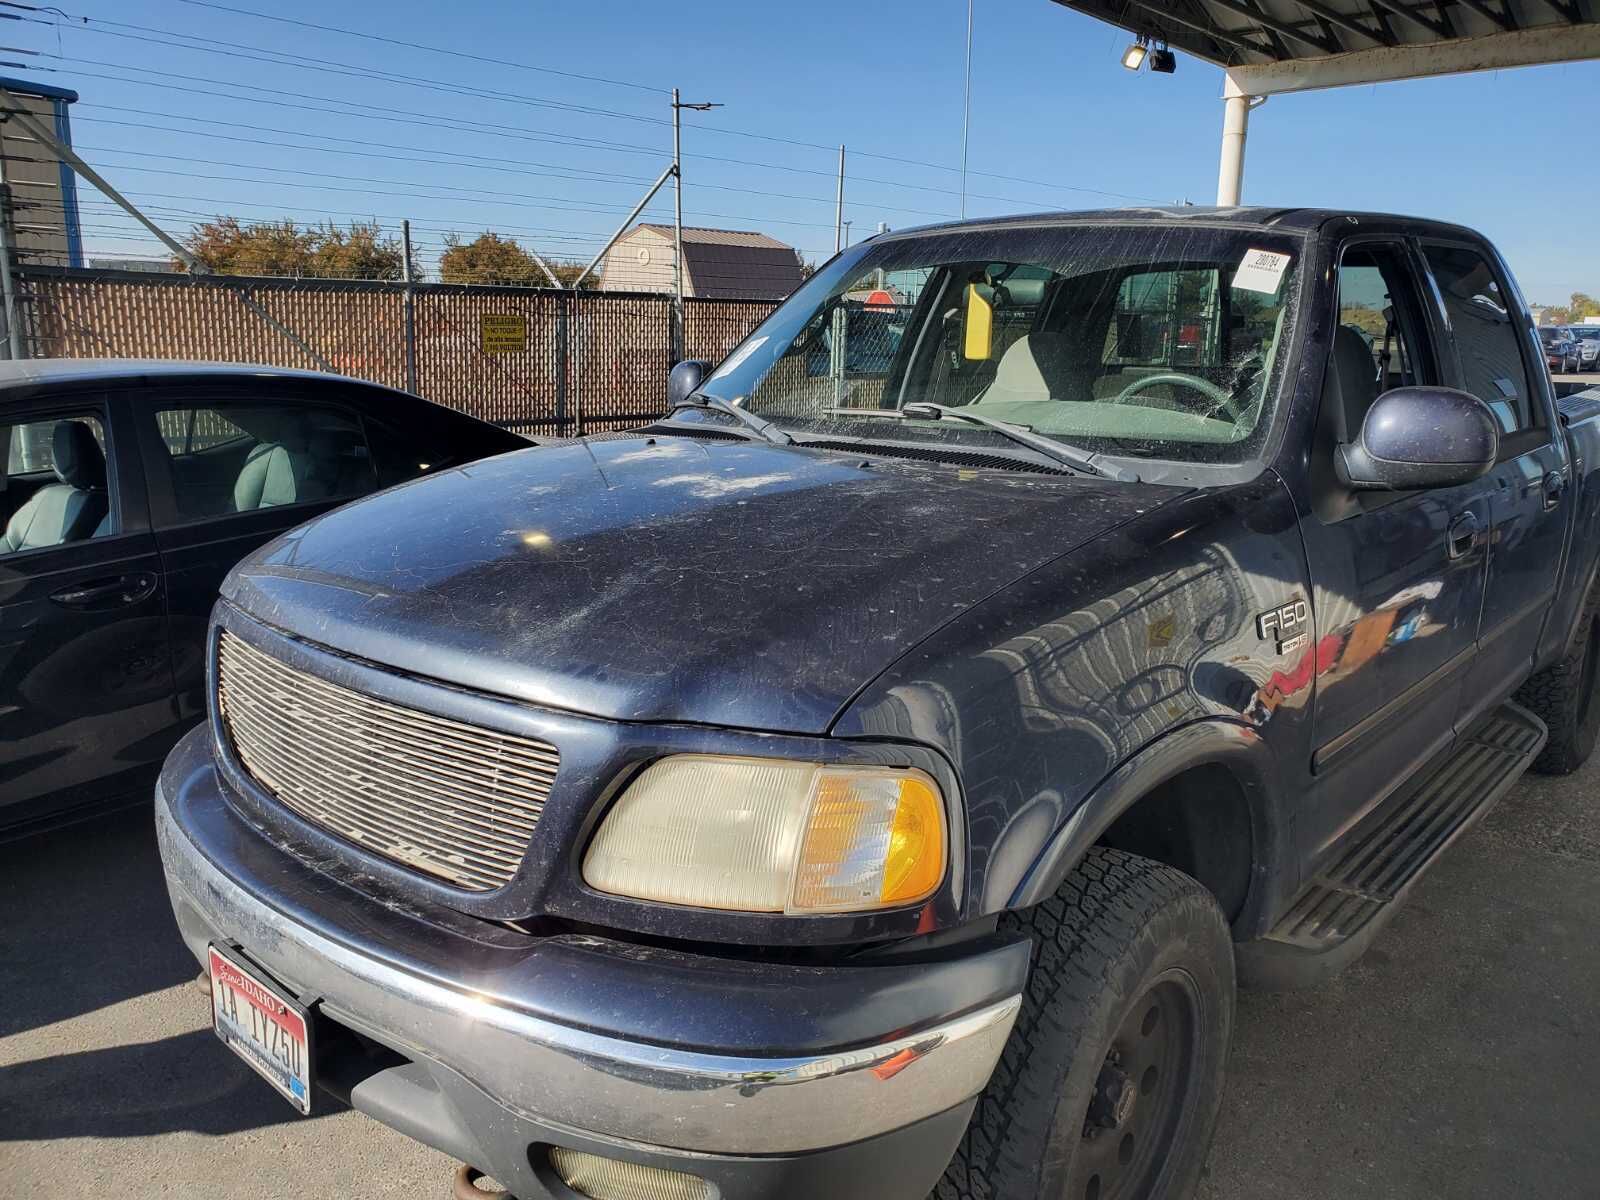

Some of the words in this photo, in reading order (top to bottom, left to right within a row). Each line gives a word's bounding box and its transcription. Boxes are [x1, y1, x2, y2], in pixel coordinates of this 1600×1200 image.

[484, 317, 523, 325] PELIGRO
[219, 978, 239, 1026] 1A
[239, 975, 275, 1012] IDAHO
